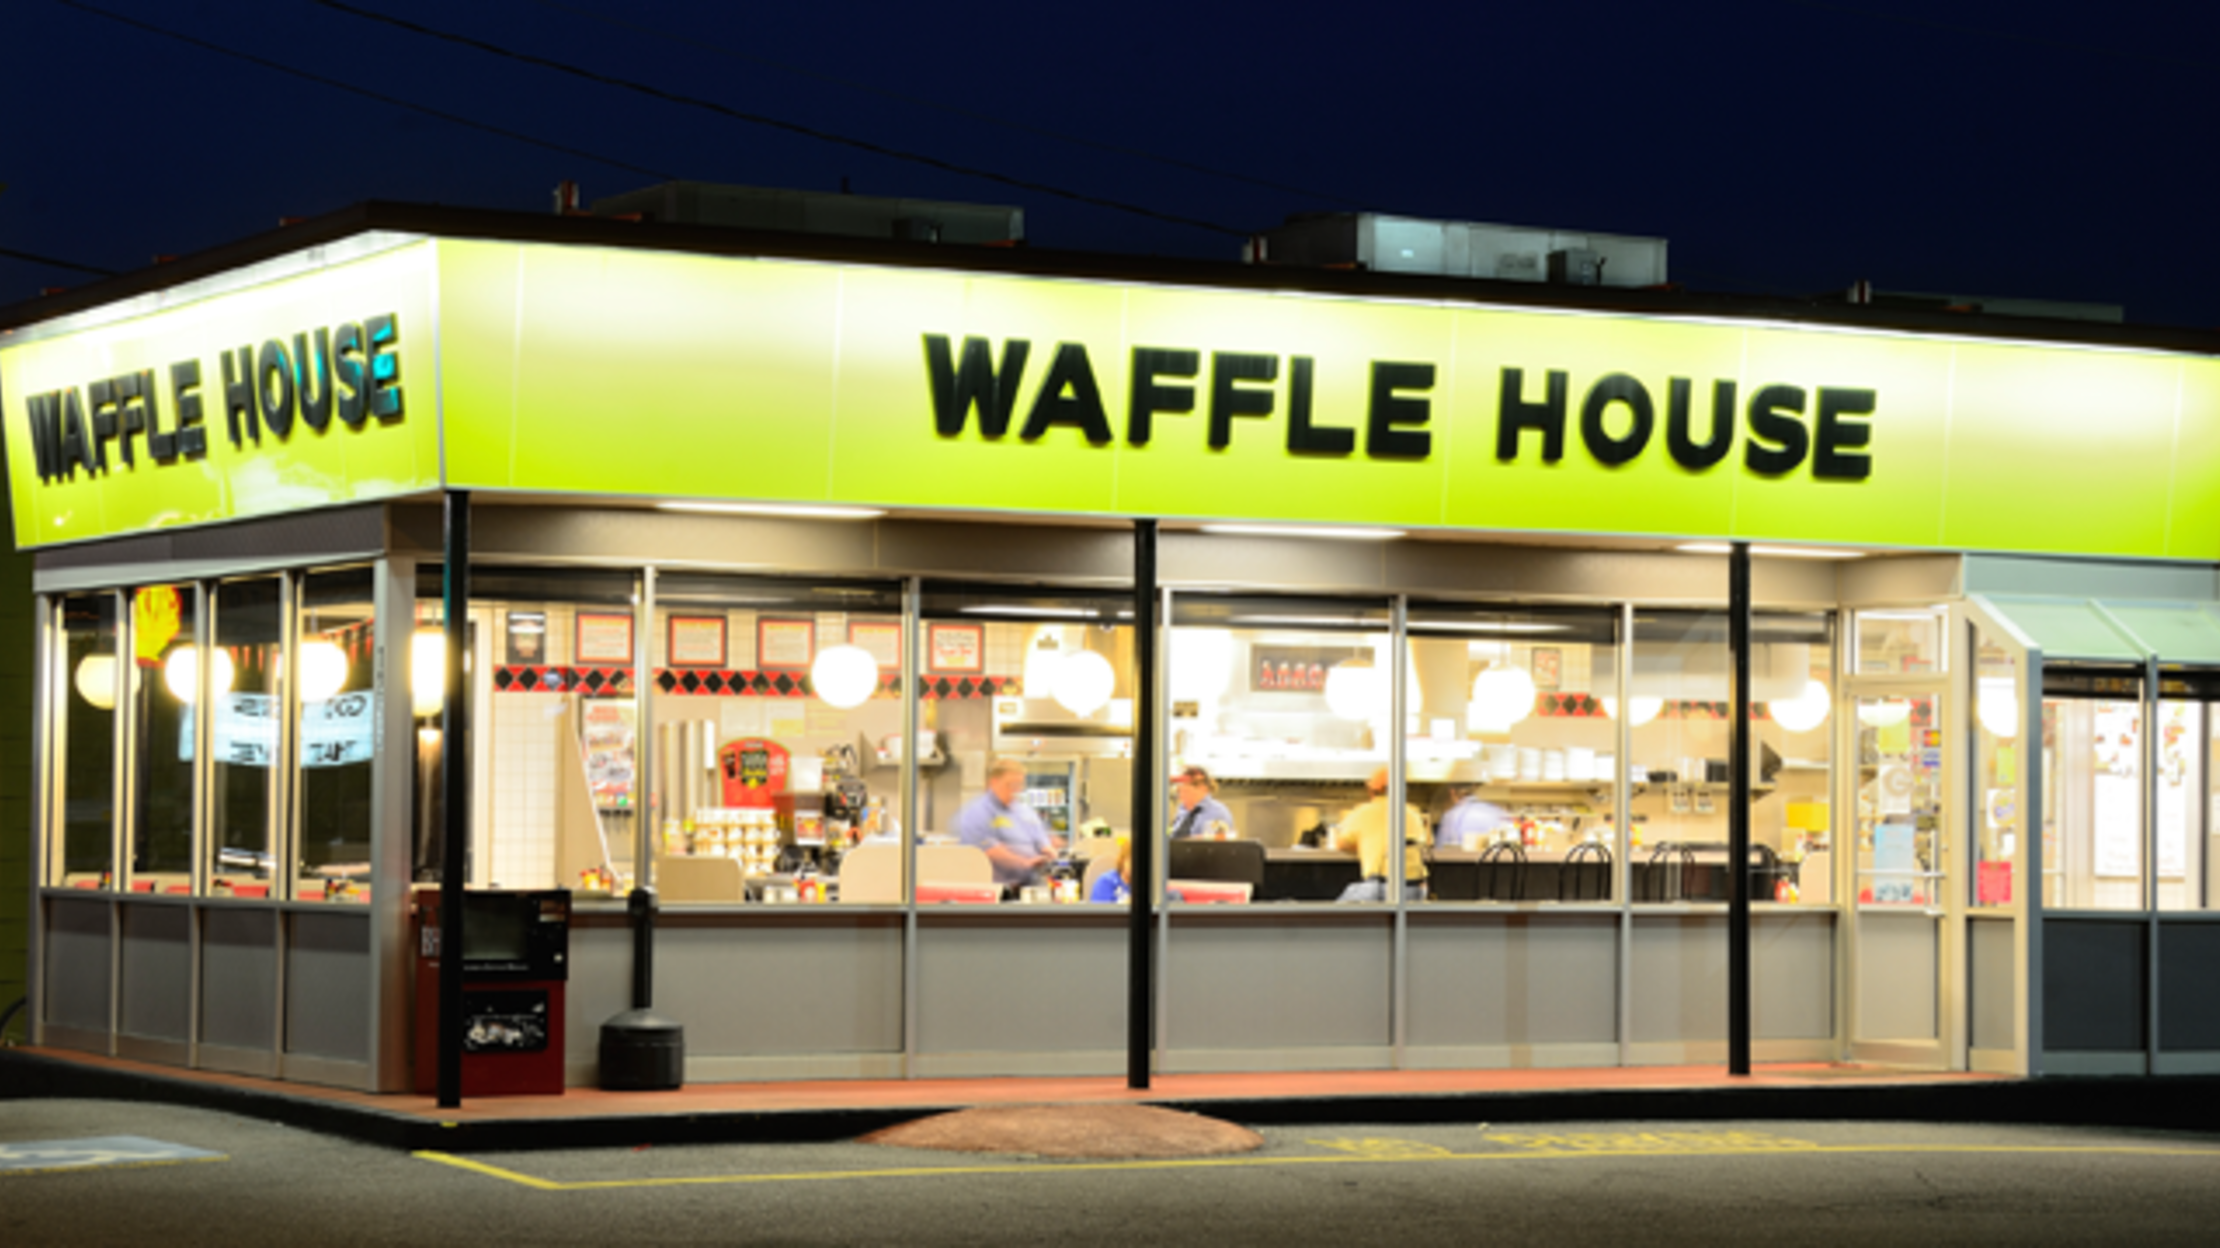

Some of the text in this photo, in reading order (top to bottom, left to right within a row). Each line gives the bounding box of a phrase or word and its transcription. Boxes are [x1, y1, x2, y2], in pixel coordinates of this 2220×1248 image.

[26, 312, 404, 485] WAFFLE HOUSE
[923, 334, 1877, 481] WAFFLE HOUSE
